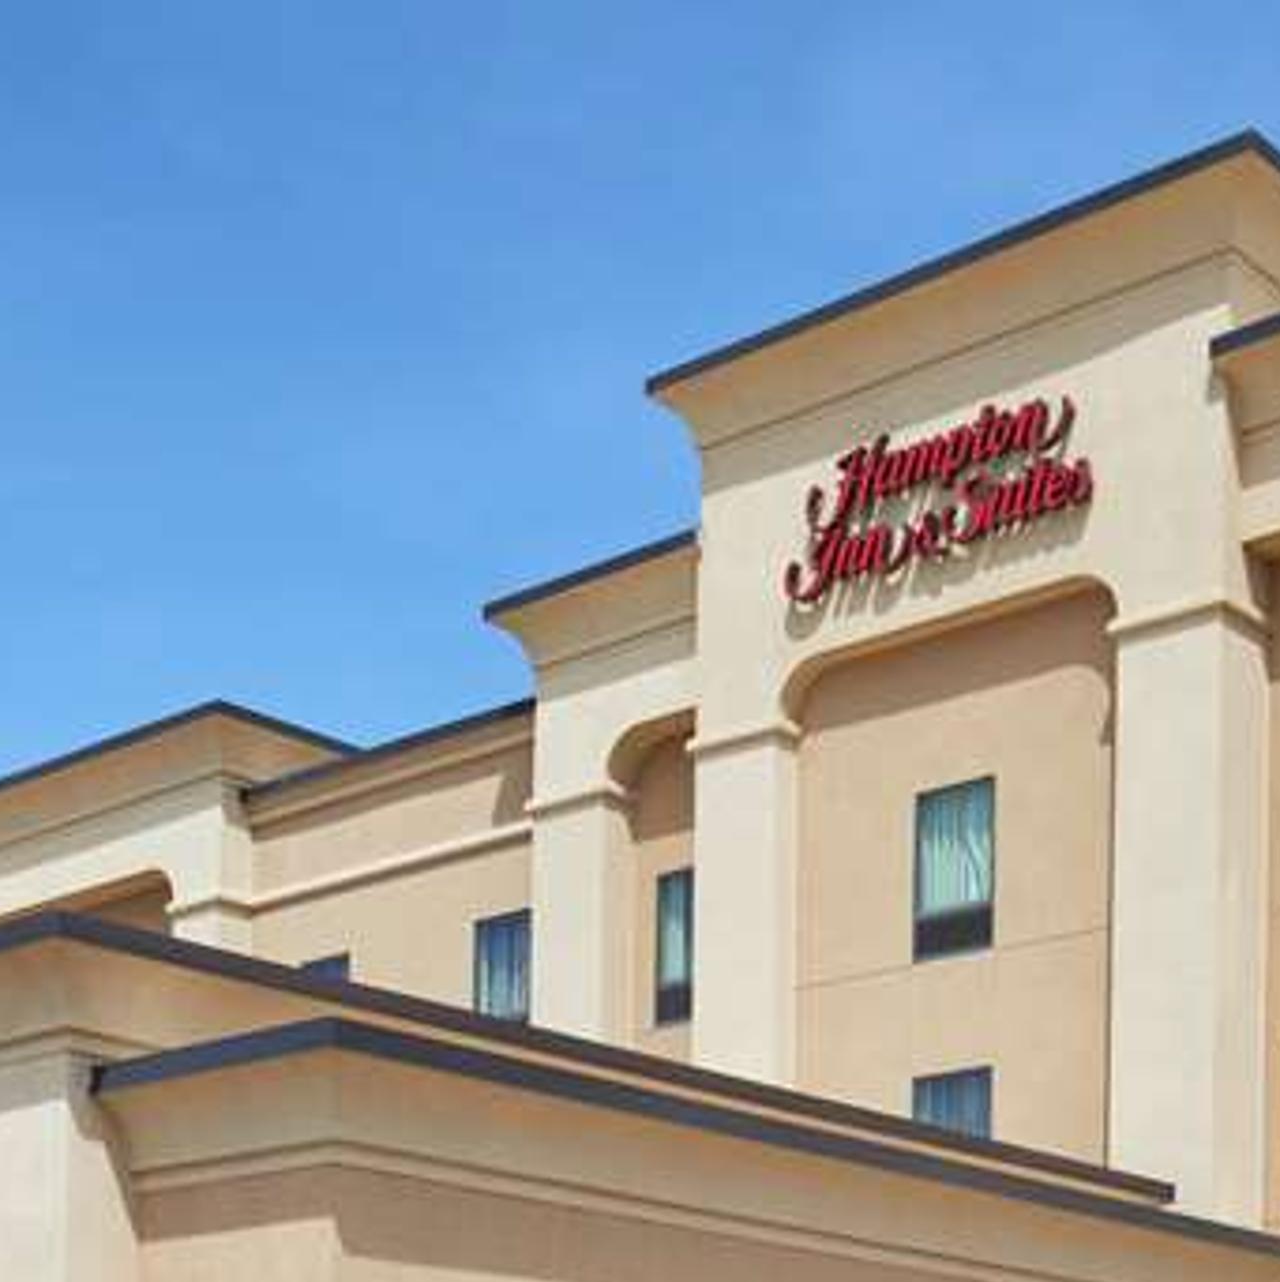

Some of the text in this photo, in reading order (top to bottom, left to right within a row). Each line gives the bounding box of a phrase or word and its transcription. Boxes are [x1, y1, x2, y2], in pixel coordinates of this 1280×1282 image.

[784, 524, 914, 603] Inn
[942, 456, 1093, 543] Suites
[807, 396, 1074, 533] Hampton
